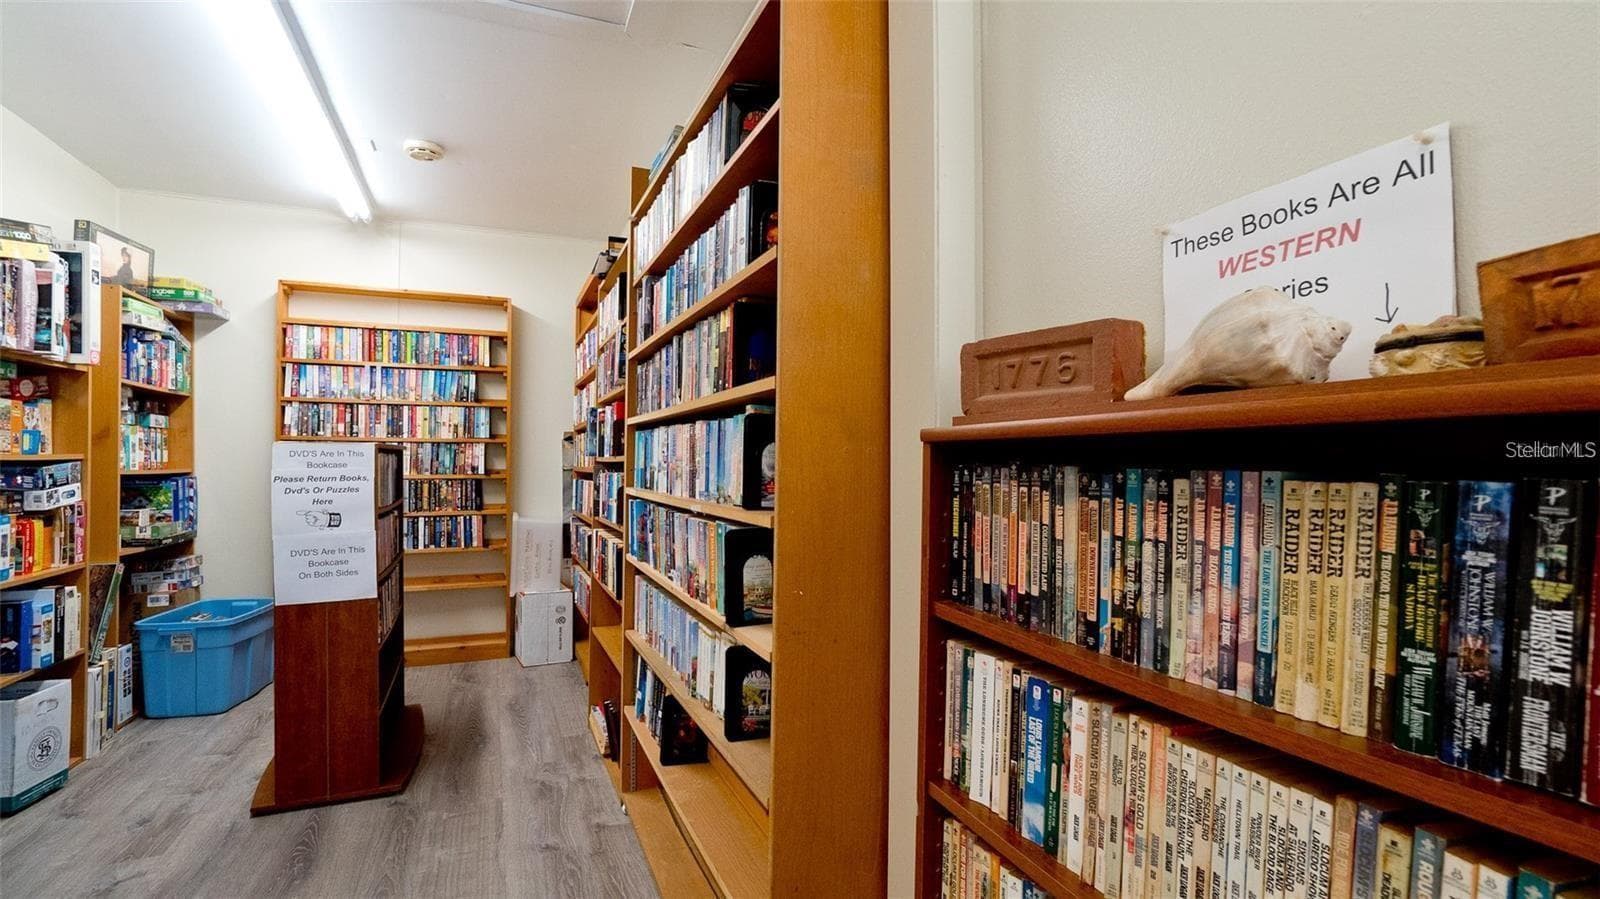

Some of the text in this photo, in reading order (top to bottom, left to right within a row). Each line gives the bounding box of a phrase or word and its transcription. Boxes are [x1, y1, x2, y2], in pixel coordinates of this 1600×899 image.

[1171, 150, 1435, 257] These Books Are All
[1218, 218, 1362, 279] WESTERN
[990, 351, 1077, 390] 1776
[306, 461, 348, 469] Bookcase
[320, 450, 335, 458] Are
[347, 449, 365, 458] This
[273, 475, 305, 483] Please
[306, 475, 337, 483] Return
[284, 487, 310, 495] Dvd's
[326, 486, 360, 494] Puzzles
[312, 498, 333, 506] Here
[290, 546, 366, 558] DVD'S Are In This
[1176, 504, 1188, 560] RAIDER
[1284, 508, 1300, 575] RAIDER
[1307, 507, 1324, 575] RAIDER
[1327, 508, 1346, 577] RAIDER
[1355, 506, 1375, 579] RAIDER
[298, 569, 359, 580] On Both Sides
[308, 559, 349, 568] Bookcase
[1126, 545, 1136, 609] DEATH FLOTILLA
[1157, 543, 1165, 572] GUNFIRE
[1223, 549, 1232, 564] THE
[1223, 565, 1232, 588] SPIRIT
[1381, 555, 1393, 570] THE
[1089, 589, 1096, 597] TO
[1143, 541, 1152, 619] SONS AND SINNERS
[1207, 555, 1218, 614] BLOODY SANDS
[1223, 589, 1232, 605] AND
[1261, 550, 1271, 649] THE LONE STAR MASSACRE
[1282, 578, 1290, 616] TRACKDOWN
[1467, 568, 1482, 632] JOHNSTONE
[1482, 571, 1496, 616] WILLIAM
[1223, 606, 1232, 620] THE
[1379, 594, 1390, 608] THE
[1404, 583, 1415, 631] SUNDOWN
[1416, 575, 1426, 642] DEAD BEFORE
[1376, 643, 1387, 658] THE
[1377, 626, 1388, 642] AND
[1530, 605, 1552, 684] JOHNSTONE
[1551, 609, 1574, 669] WILLIAM
[1374, 659, 1386, 689] DEADLY
[1028, 735, 1035, 743] OF
[1464, 690, 1476, 749] MOUNTAIN MAN
[1473, 705, 1483, 739] THE LAST
[1520, 696, 1549, 775] FRONTIERSMAN
[1100, 727, 1108, 773] HANGING
[1453, 728, 1463, 758] TEXAS
[1550, 731, 1567, 751] THE
[1089, 719, 1100, 815] SLOCUM'S REVENGE
[1136, 750, 1147, 830] SLOCUM'S GOLD
[1187, 780, 1195, 818] SLOCUM
[1177, 769, 1188, 861] CHEROKEE MANHUNT
[1187, 819, 1195, 838] AND
[1195, 797, 1203, 825] DAWN
[1202, 787, 1211, 841] MESCALERO
[1234, 799, 1242, 840] HELLTOWN
[1255, 812, 1263, 846] POWDER
[1218, 813, 1226, 859] COMANCHE
[1248, 817, 1256, 858] MASSACRE
[1265, 814, 1278, 895] THE BLOOD RAGE
[1309, 829, 1320, 871] LAREDO
[1275, 826, 1286, 891] SLOCUM AND
[1285, 823, 1298, 892] AT SILVERADO
[1296, 839, 1307, 886] SIXGUNS
[1319, 843, 1331, 890] SLOCUM
